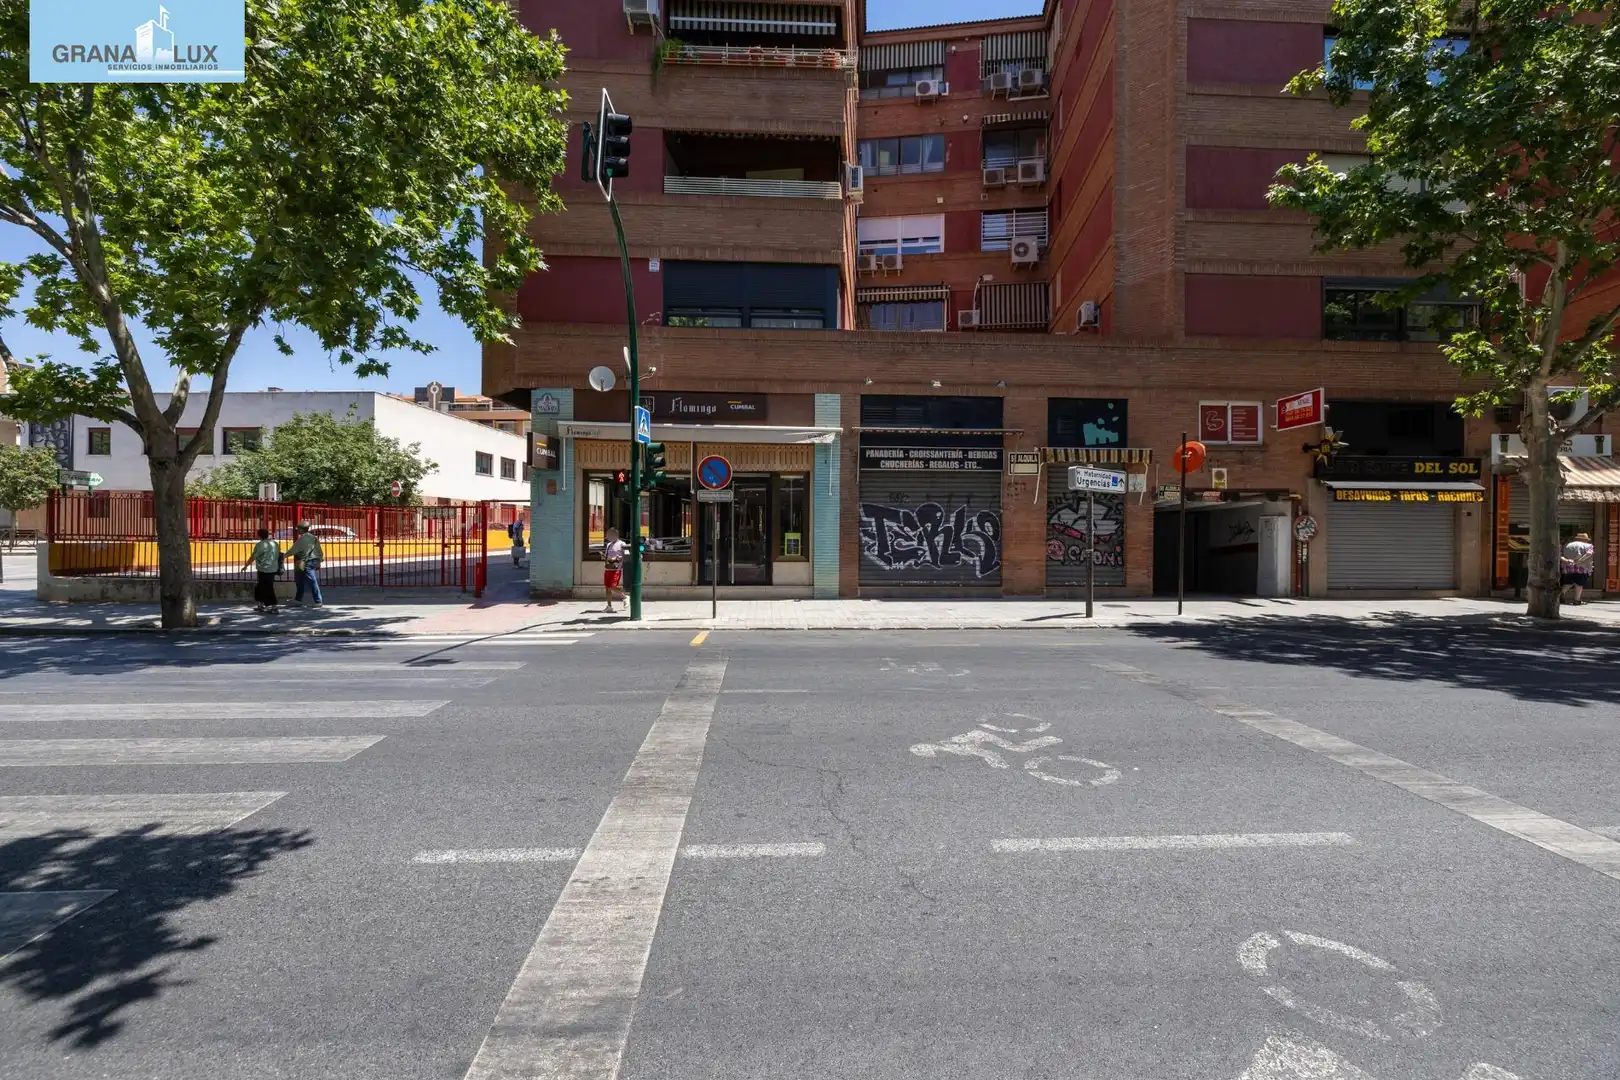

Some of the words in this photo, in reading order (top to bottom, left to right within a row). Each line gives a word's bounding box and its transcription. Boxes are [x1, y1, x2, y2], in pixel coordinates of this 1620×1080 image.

[866, 448, 904, 458] PANADERÍA
[909, 448, 964, 459] CROISSANTERÍA
[968, 449, 998, 459] BEBIDAS
[1018, 454, 1038, 463] ALQUILA
[880, 459, 925, 469] CHUCHERÍAS
[929, 460, 960, 469] REGALOS
[1414, 462, 1443, 474] DEL
[1448, 462, 1478, 474] SOL
[1077, 477, 1111, 488] Urgencias
[1400, 490, 1429, 501] TAPAS
